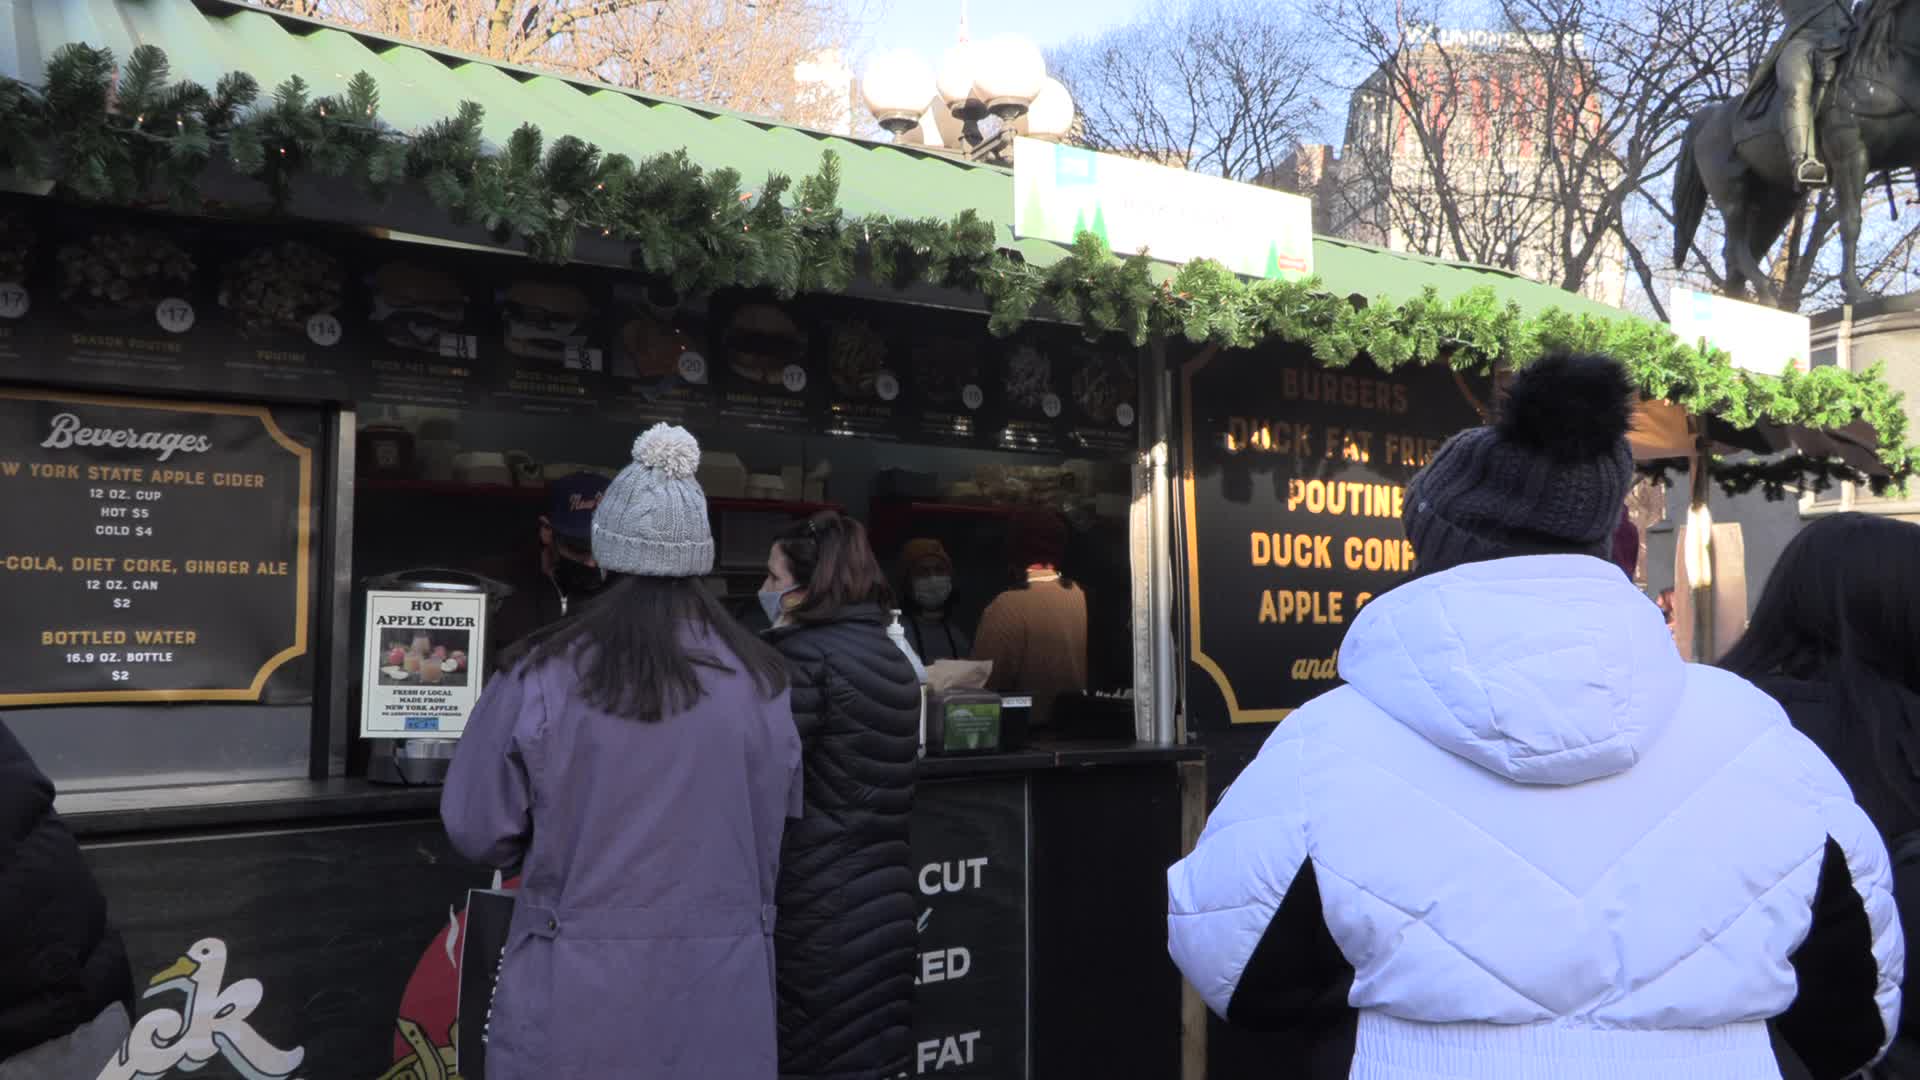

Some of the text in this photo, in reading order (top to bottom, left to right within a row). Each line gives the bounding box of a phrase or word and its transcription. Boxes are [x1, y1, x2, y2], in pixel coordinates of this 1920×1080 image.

[1440, 28, 1502, 48] UNION
[1284, 368, 1409, 413] BURGERS
[40, 413, 212, 461] Beverages
[1227, 416, 1313, 457] DUCK
[1326, 426, 1372, 463] FAT
[31, 463, 80, 480] YORK
[88, 466, 143, 482] STATE
[151, 470, 205, 485] APPLE
[213, 472, 265, 488] CIDER
[90, 489, 162, 501] 12 OZ. CUP
[1288, 479, 1406, 519] POUTINE
[100, 507, 149, 519] HOT $5
[95, 525, 152, 537] COLD $4
[1251, 531, 1332, 568] DUCK
[72, 557, 115, 572] DIET
[123, 558, 177, 574] COKE,
[185, 560, 250, 574] GINGER
[256, 562, 289, 576] ALE
[86, 580, 158, 591] 12 OZ. CAN
[113, 598, 131, 609] $2
[411, 601, 443, 612] HOT
[1259, 589, 1343, 625] APPLE
[376, 615, 475, 627] APPLE CIDER
[42, 630, 196, 645] BOTTLED WATER
[66, 652, 173, 663] 16.9 OZ. BOTTLE
[1291, 648, 1337, 680] and
[111, 670, 129, 681] $2
[918, 857, 988, 895] CUT
[914, 947, 971, 985] ED
[917, 1030, 981, 1075] FAT
